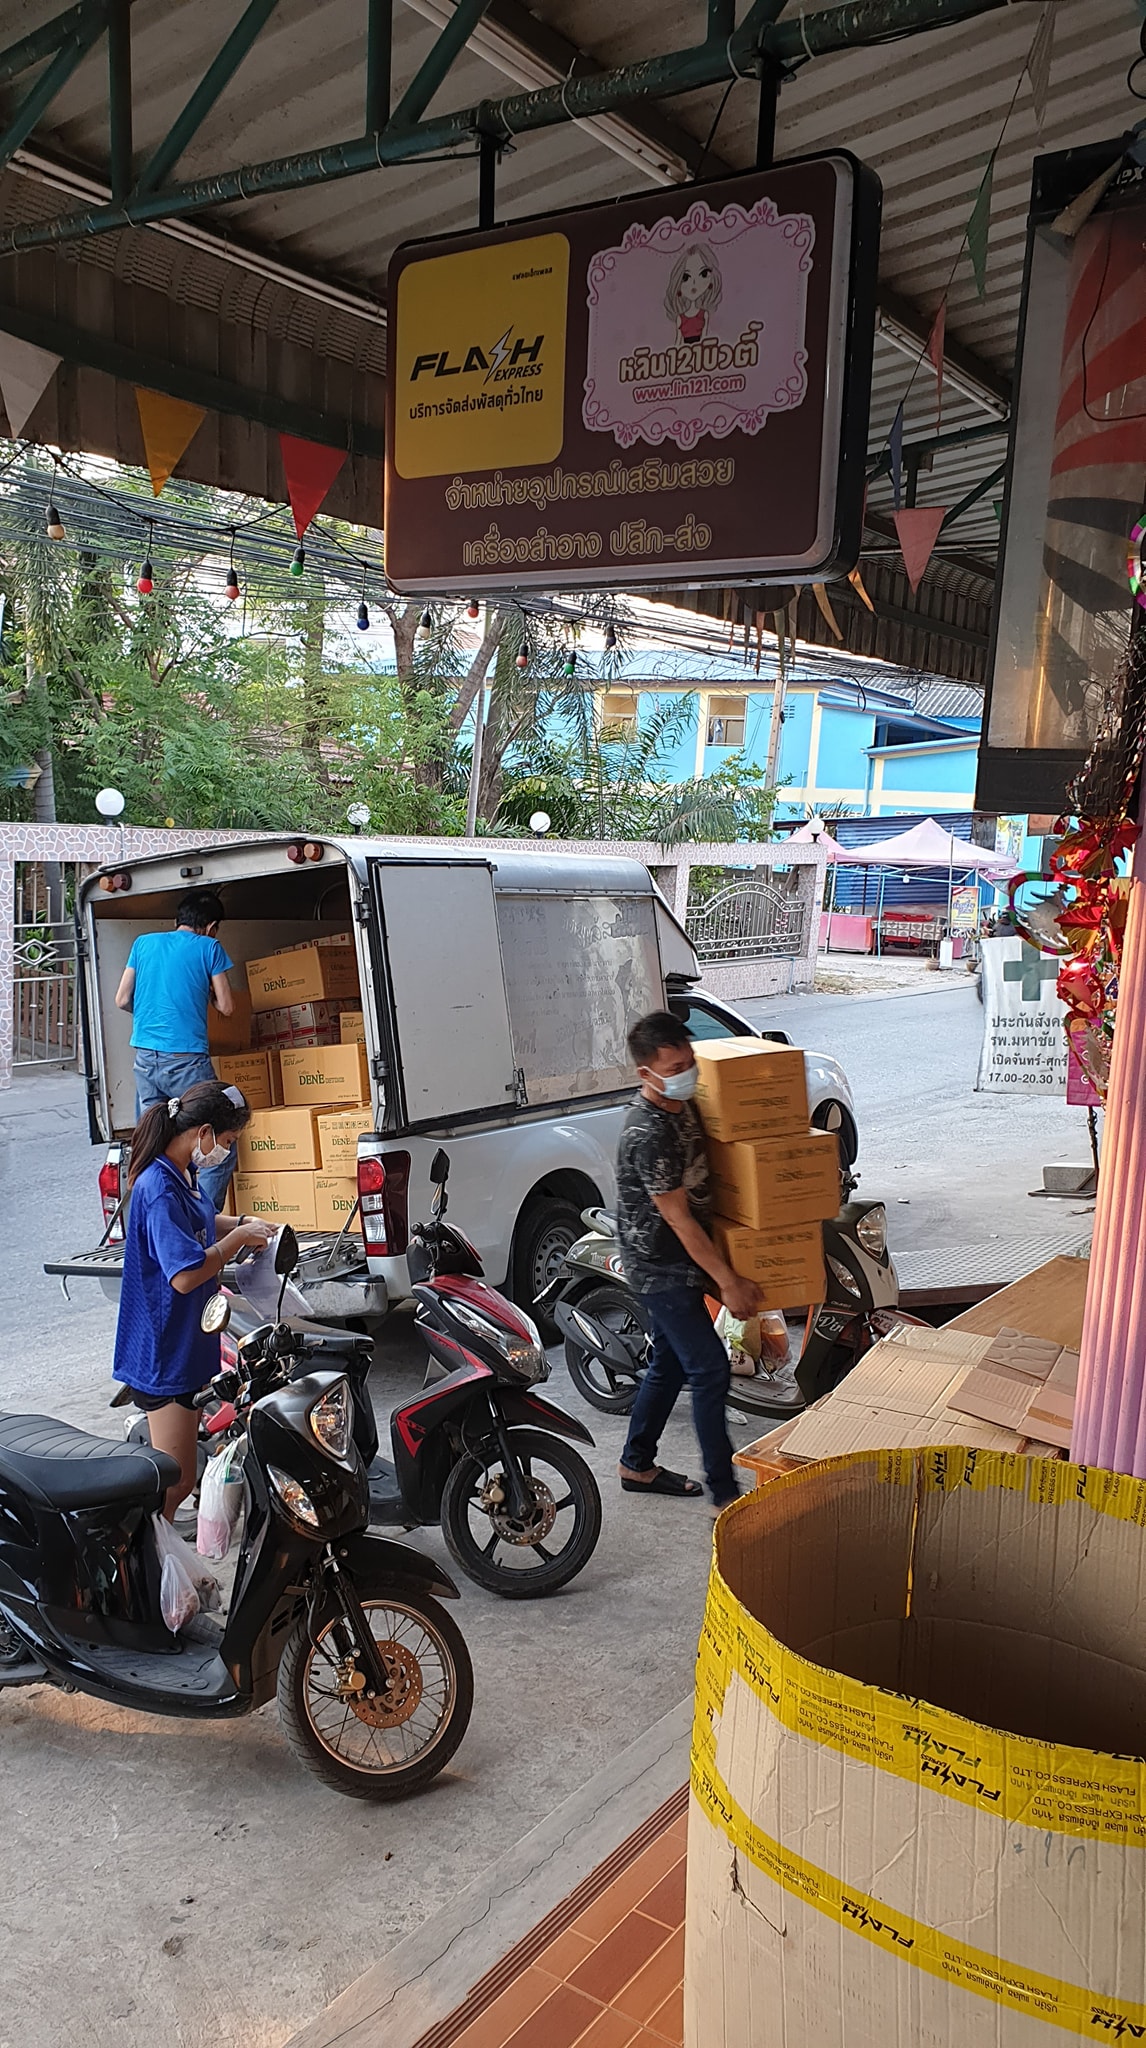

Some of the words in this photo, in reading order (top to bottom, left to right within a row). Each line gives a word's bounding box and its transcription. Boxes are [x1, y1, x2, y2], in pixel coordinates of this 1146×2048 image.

[410, 325, 545, 385] FLASH
[619, 320, 764, 383] หลิน121บิวตี้
[493, 363, 544, 382] EXPRESS
[635, 376, 743, 401] www.lin121.com
[409, 385, 544, 420] บริการจัดส่งพัสดุทั่วไทย
[445, 458, 735, 511] จำหน่ายอุปกรณ์เสริมสวย
[463, 522, 602, 566] เครื่องสำอาง
[610, 513, 712, 556] ปลีก-ส่ง
[990, 1031, 1056, 1047] รพ.มหาชัย
[992, 1050, 1068, 1072] เปิดจันทร์-ศุกร์
[988, 1073, 1053, 1084] 17.00-20.30
[920, 1760, 1001, 1801] FLASH
[1051, 1775, 1100, 1789] EXPRESS
[1102, 1783, 1135, 1795] FLASH
[1074, 1805, 1122, 1818] EXPRESS
[841, 1903, 914, 1948] FLASH
[1026, 1985, 1058, 2002] FLASH
[1090, 2013, 1145, 2038] ASH
